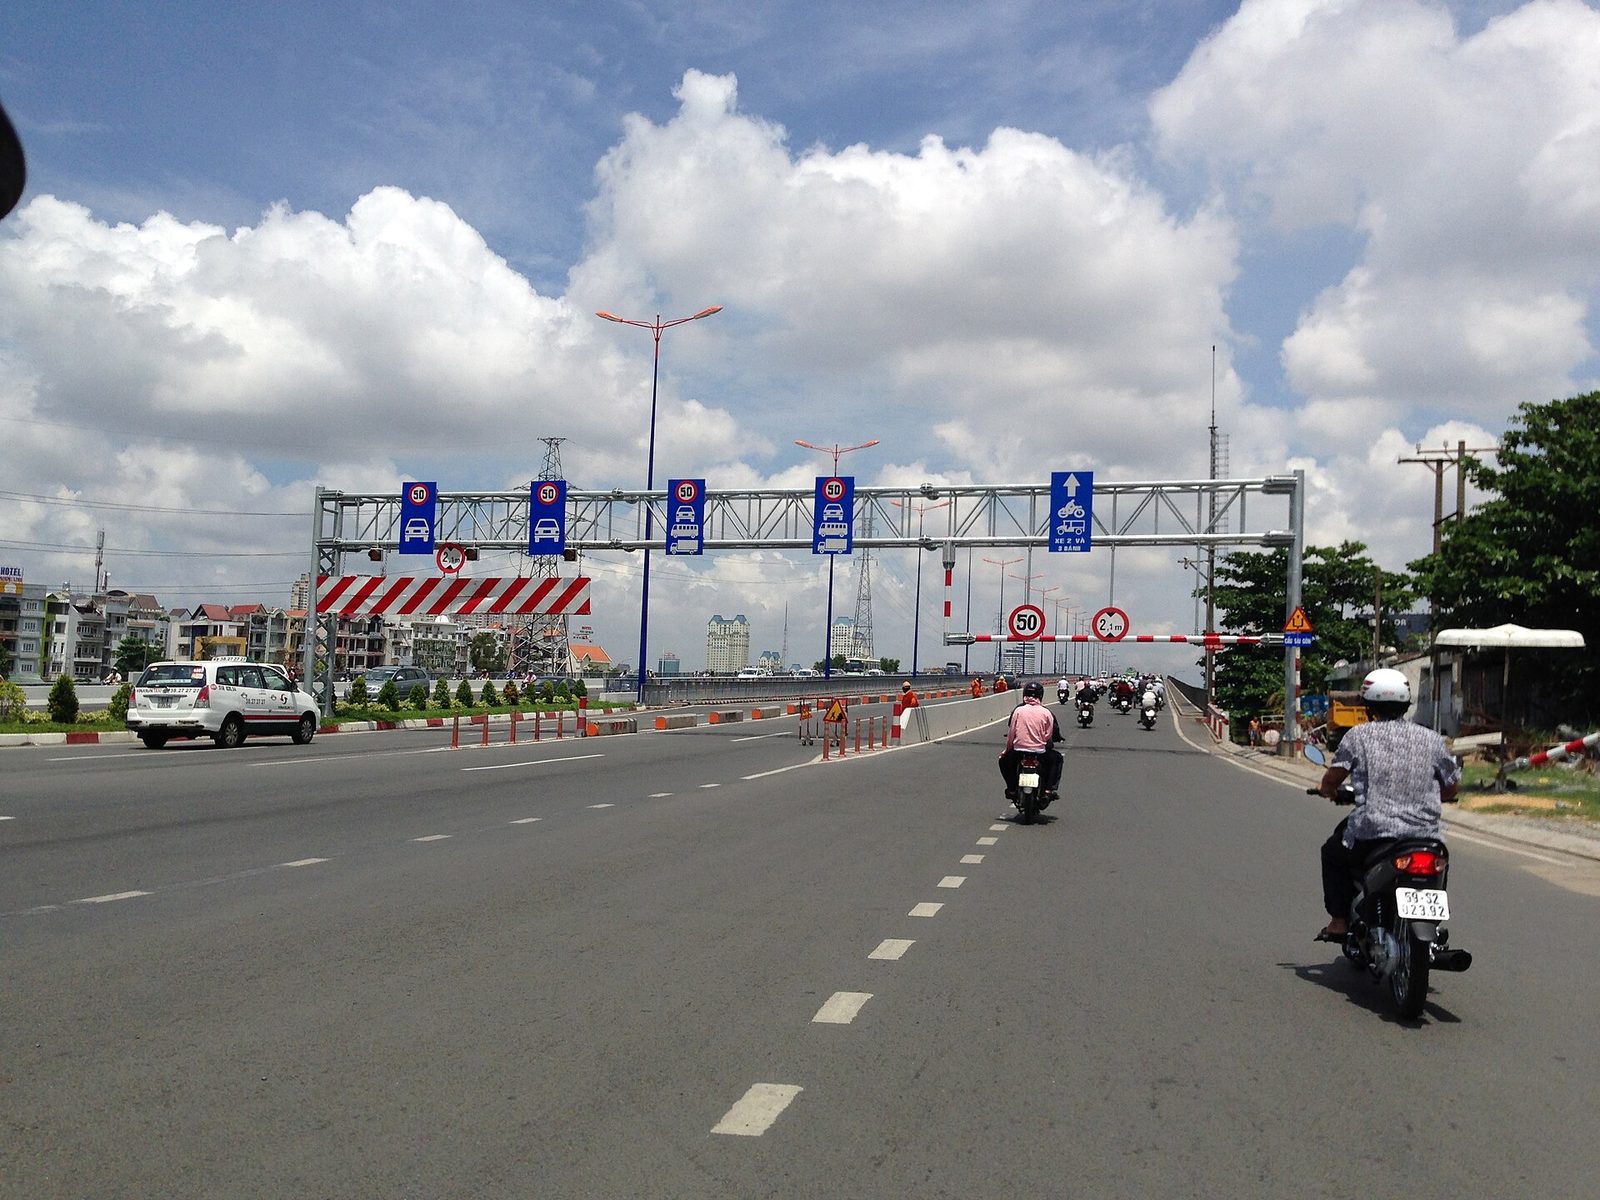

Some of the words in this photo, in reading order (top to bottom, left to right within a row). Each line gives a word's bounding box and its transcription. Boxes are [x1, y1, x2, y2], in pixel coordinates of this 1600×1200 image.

[413, 490, 424, 500] 50
[542, 489, 554, 499] 50
[680, 486, 692, 497] 50
[827, 485, 840, 495] 50
[1075, 536, 1085, 544] VÀ
[0, 566, 22, 577] HOTEL
[1016, 613, 1037, 631] 50
